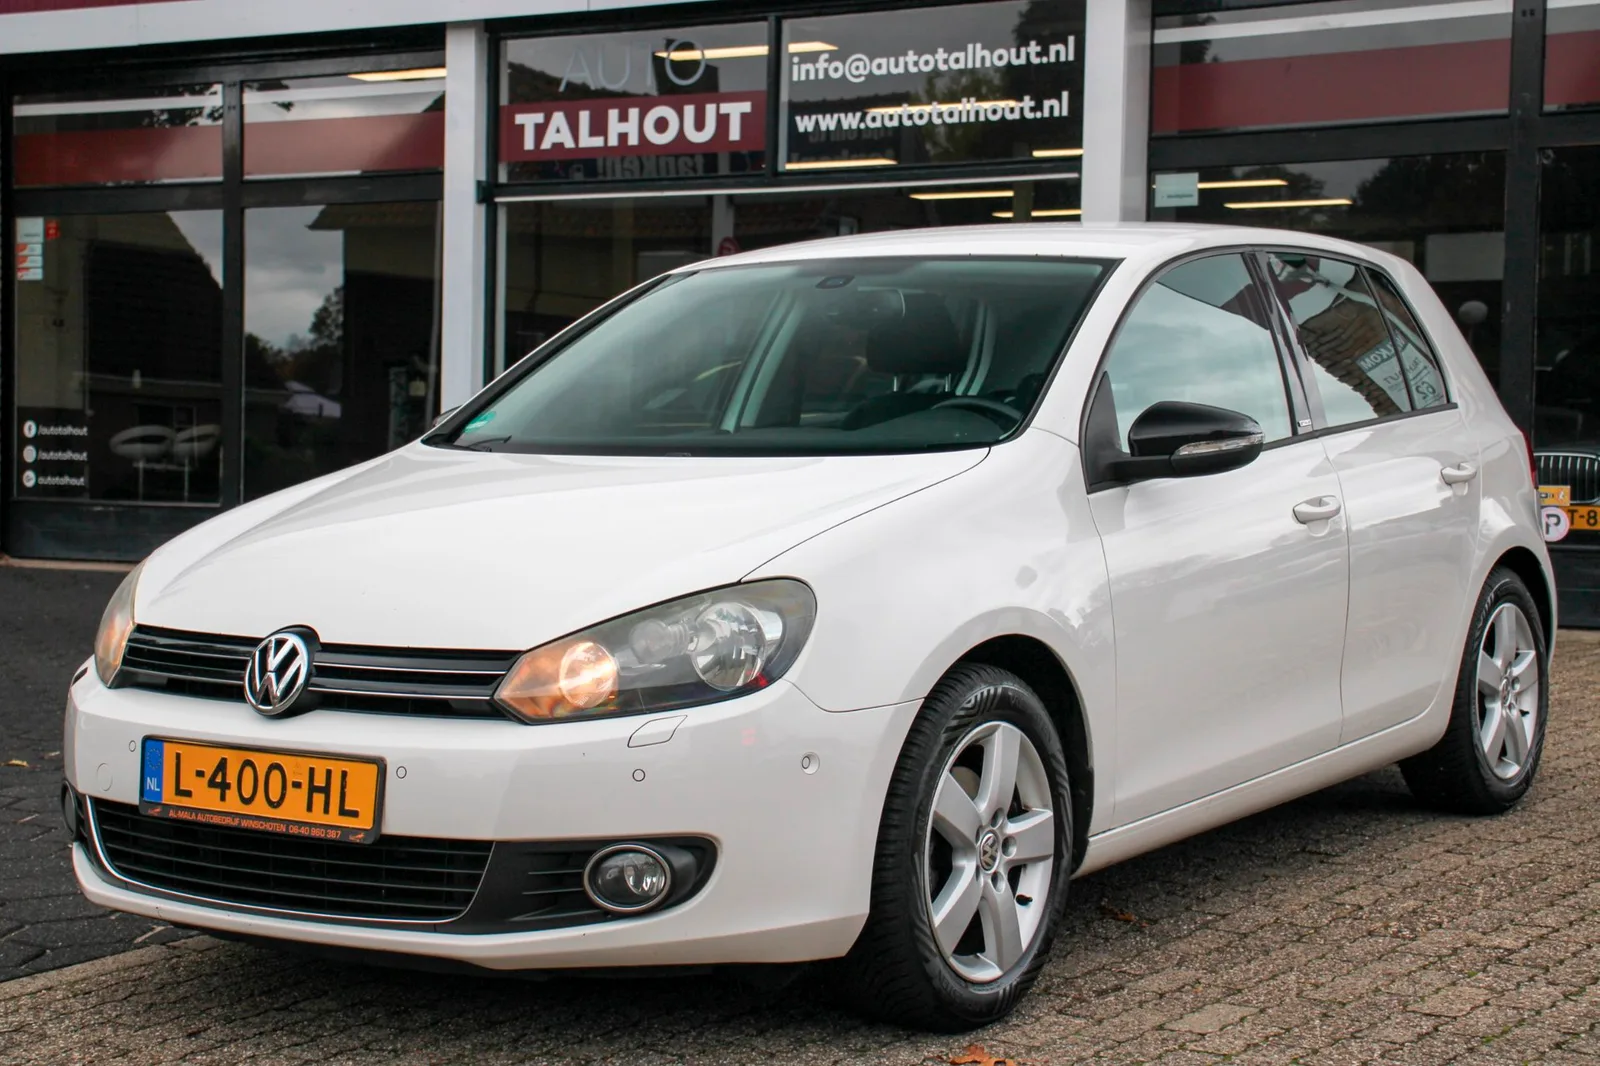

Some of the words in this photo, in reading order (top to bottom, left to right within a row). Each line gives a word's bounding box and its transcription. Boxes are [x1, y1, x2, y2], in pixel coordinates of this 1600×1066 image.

[558, 38, 706, 91] AUTO
[791, 35, 1075, 83] info@autotalhout.nl
[514, 101, 752, 151] TALHOUT
[795, 91, 1070, 134] www.autotalhout.nl
[146, 777, 160, 792] NL
[174, 751, 360, 818] L-400-HL
[197, 813, 240, 826] AUTOBEDRIJF
[241, 819, 286, 832] WINSCHOTEN
